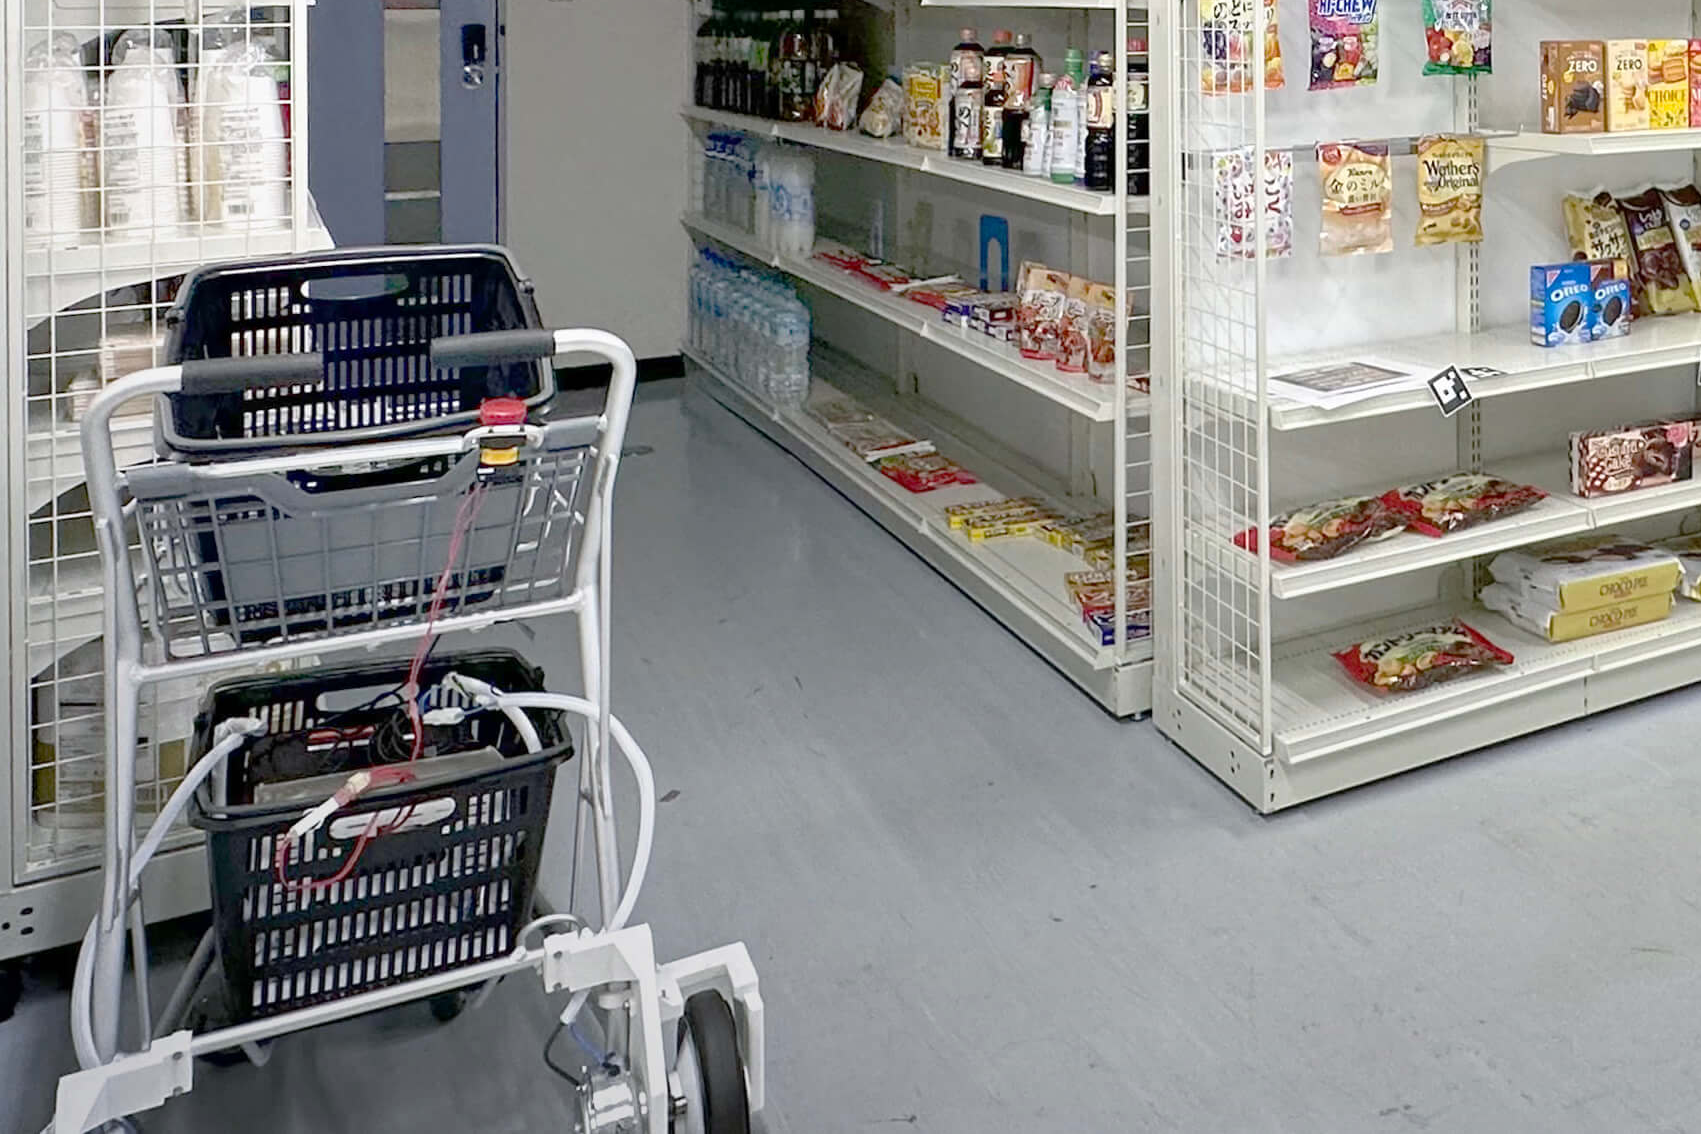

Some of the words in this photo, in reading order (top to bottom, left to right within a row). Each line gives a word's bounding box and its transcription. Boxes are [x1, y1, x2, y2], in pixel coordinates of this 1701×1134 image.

[1568, 60, 1598, 73] ZERO
[1616, 58, 1642, 71] ZERO
[1649, 88, 1686, 103] CHOICE
[1550, 283, 1588, 302] OREO
[1595, 282, 1627, 300] OREO
